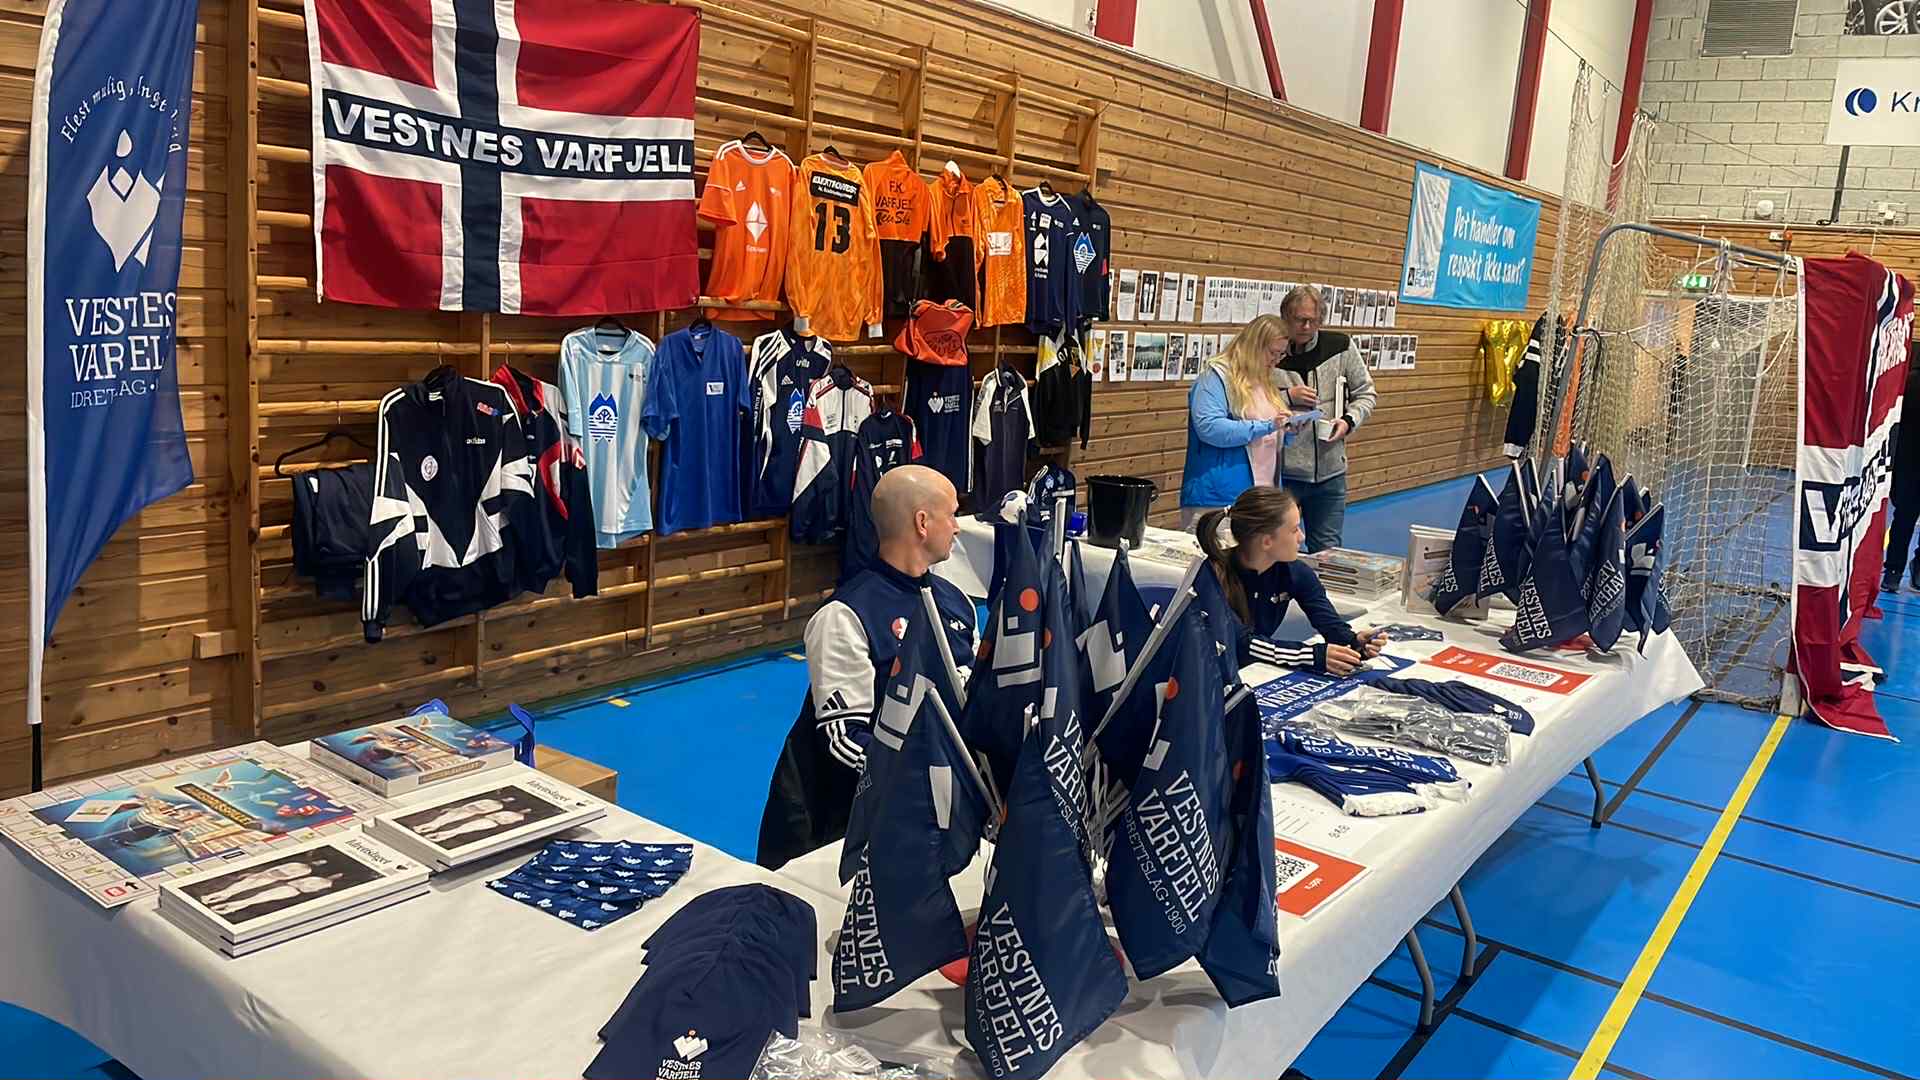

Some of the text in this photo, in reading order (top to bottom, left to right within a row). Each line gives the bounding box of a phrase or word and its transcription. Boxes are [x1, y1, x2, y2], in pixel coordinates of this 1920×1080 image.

[60, 100, 91, 143] Flest
[327, 97, 692, 174] VESTNES VARFJELL
[814, 202, 851, 254] 13
[1453, 206, 1516, 249] Det handler om
[1483, 252, 1502, 282] ikke
[1525, 576, 1553, 639] VESTNES
[1136, 788, 1207, 923] VARFJELL
[1164, 769, 1220, 896] VESTNES
[977, 913, 1035, 1073] VARFJELL
[991, 901, 1064, 1053] VESTNES
[657, 1066, 702, 1080] VARFJELL
[662, 1058, 702, 1071] VESTNES
